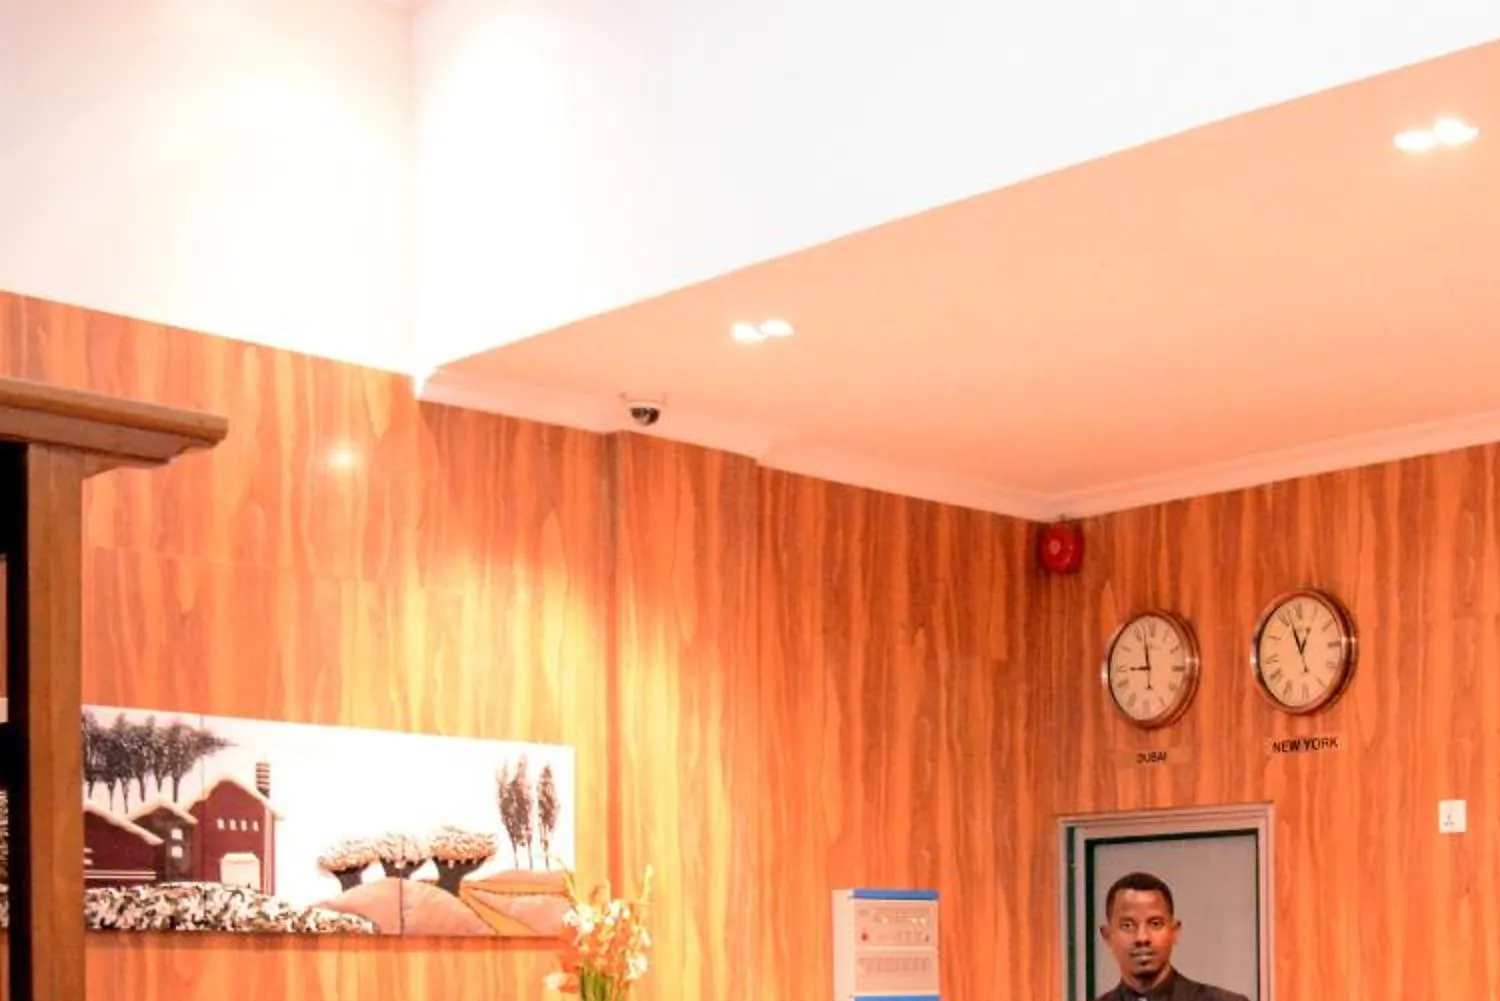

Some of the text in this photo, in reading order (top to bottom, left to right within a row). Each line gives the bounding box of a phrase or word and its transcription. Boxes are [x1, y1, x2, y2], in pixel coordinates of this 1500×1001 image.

[1272, 737, 1338, 753] NEW YORK
[1136, 751, 1167, 764] DUBAI
